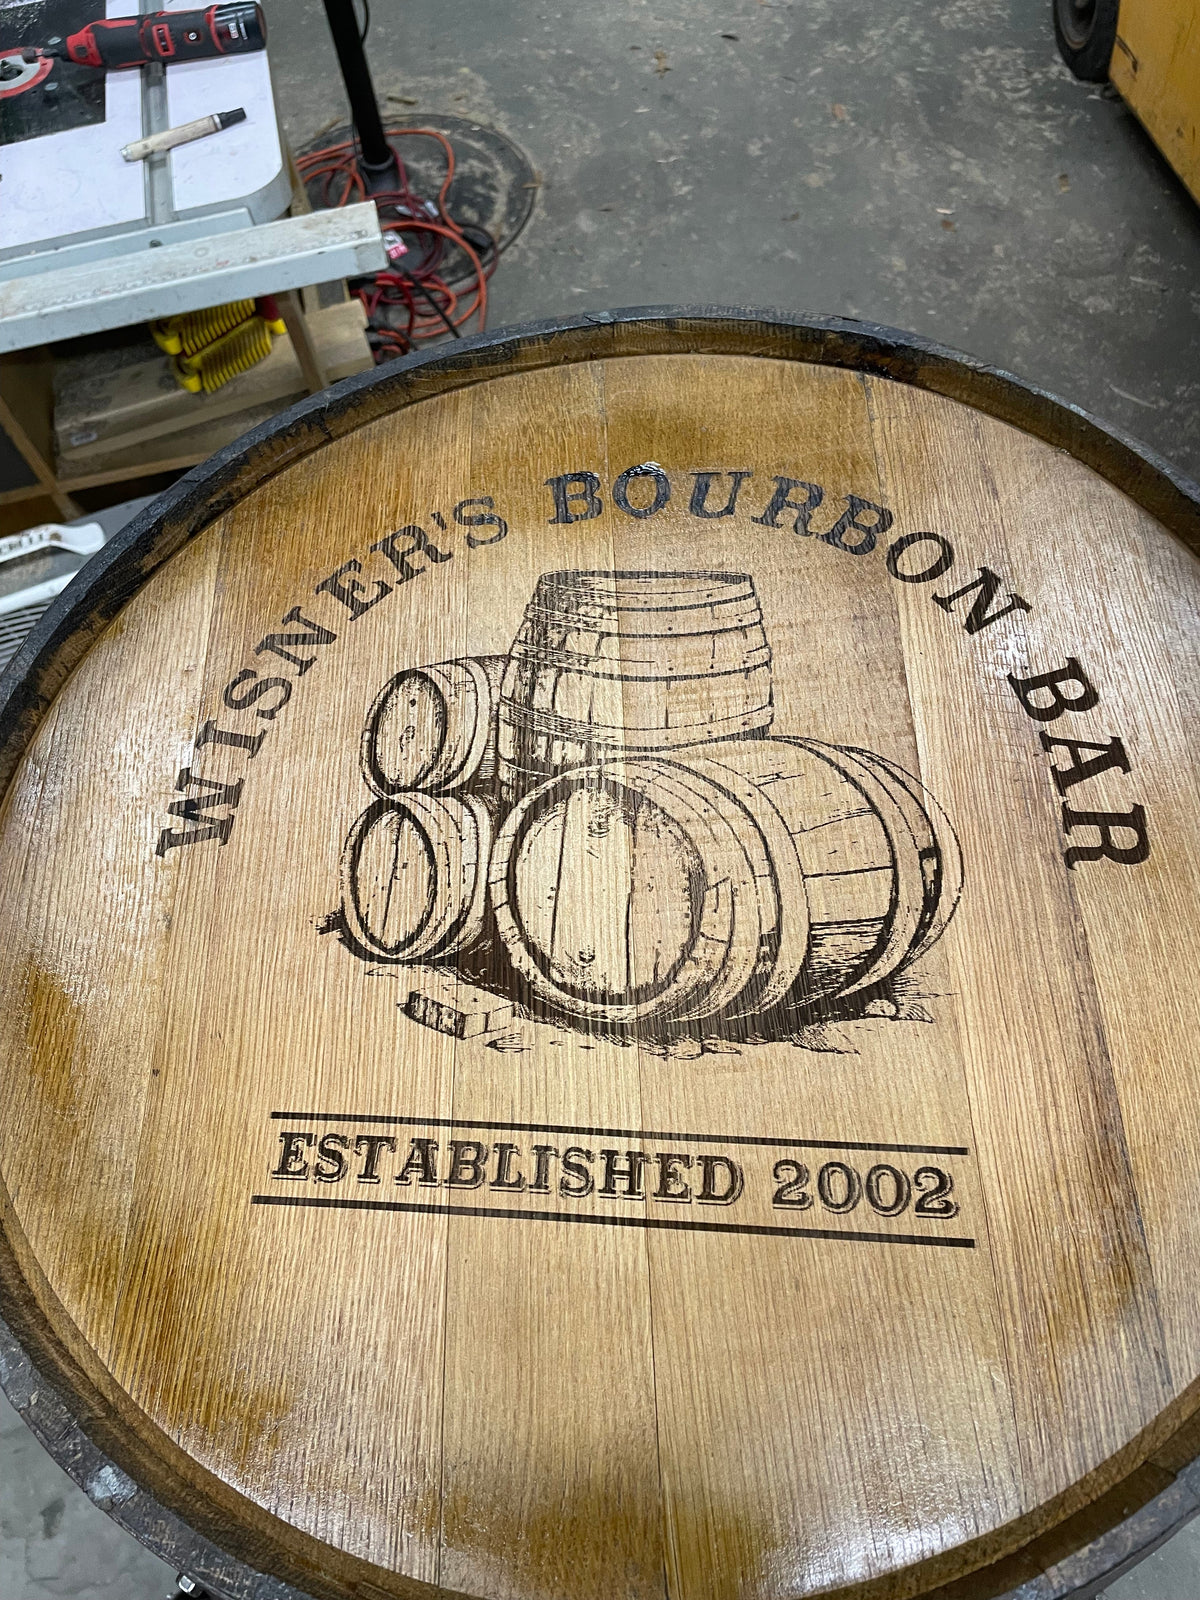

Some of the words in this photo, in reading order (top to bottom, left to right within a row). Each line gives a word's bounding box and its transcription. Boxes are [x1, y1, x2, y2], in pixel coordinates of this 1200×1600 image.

[155, 496, 508, 857] WISNER'S
[544, 462, 1031, 635] BOURBON
[1007, 657, 1150, 870] BAR
[271, 1132, 744, 1205] ESTABLISHED
[773, 1158, 961, 1219] 2002
